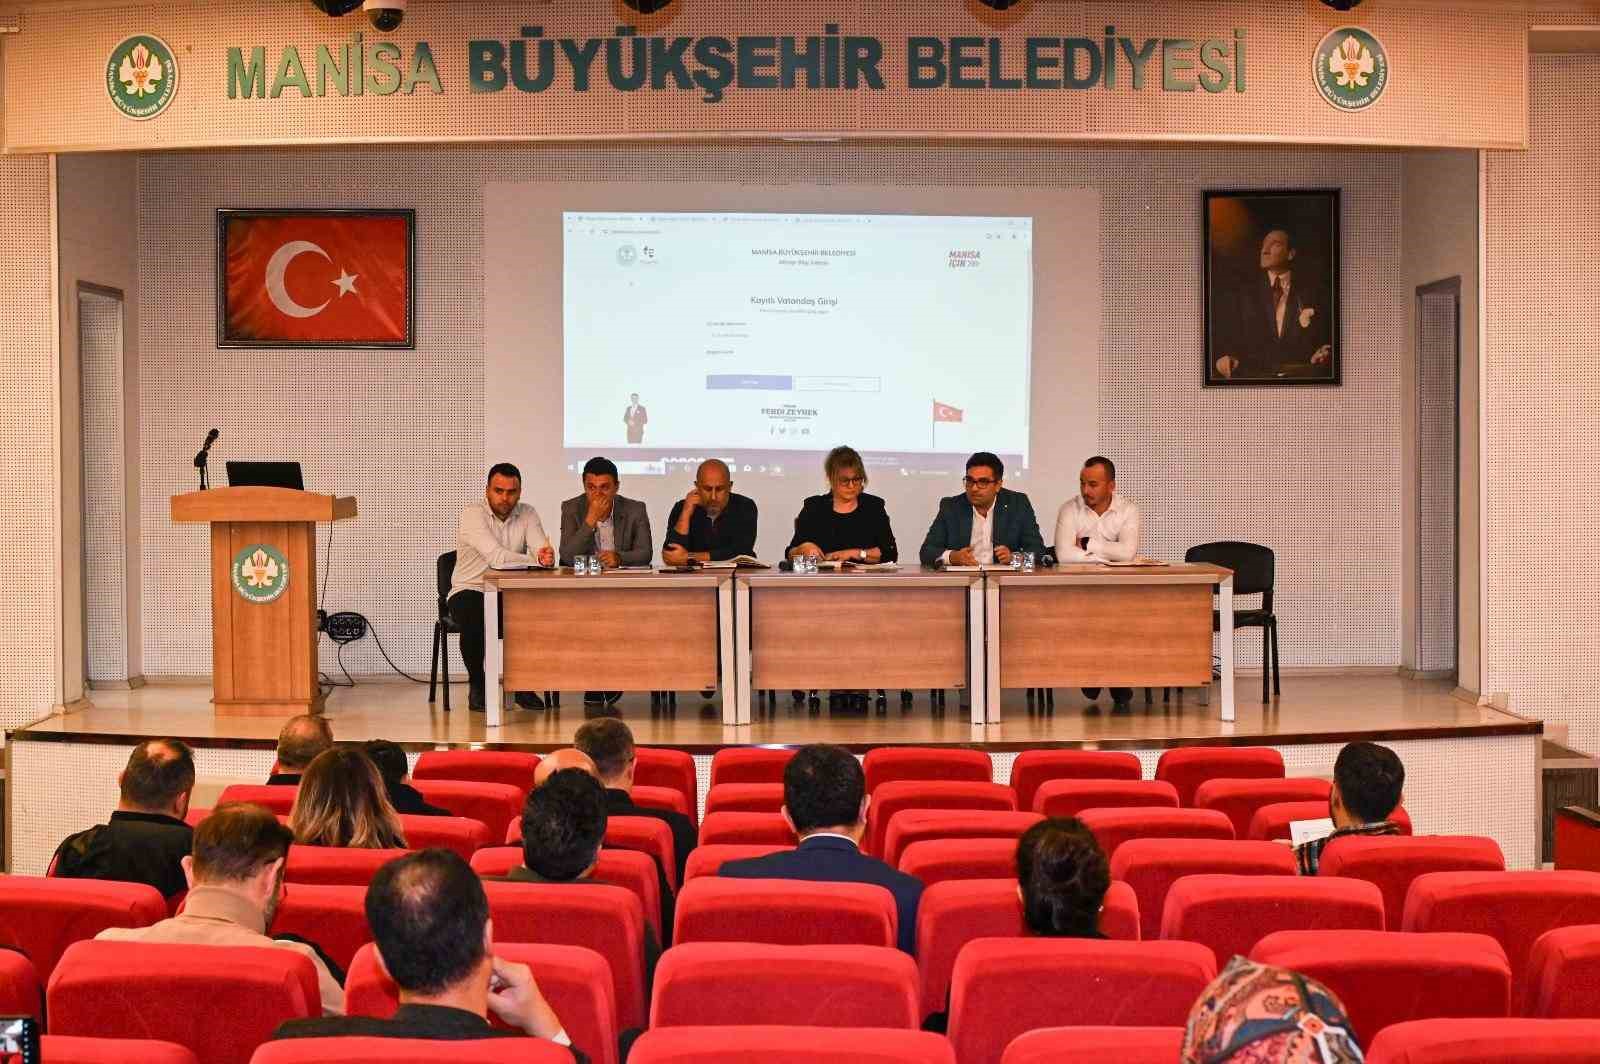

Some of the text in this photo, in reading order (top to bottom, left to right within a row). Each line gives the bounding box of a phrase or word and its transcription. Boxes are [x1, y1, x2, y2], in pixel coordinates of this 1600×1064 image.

[227, 24, 1247, 103] MANİSA BÜYÜKŞEHİR BELEDİYESİ
[750, 296, 776, 306] Kayıtlı
[777, 296, 815, 307] Vatandaş
